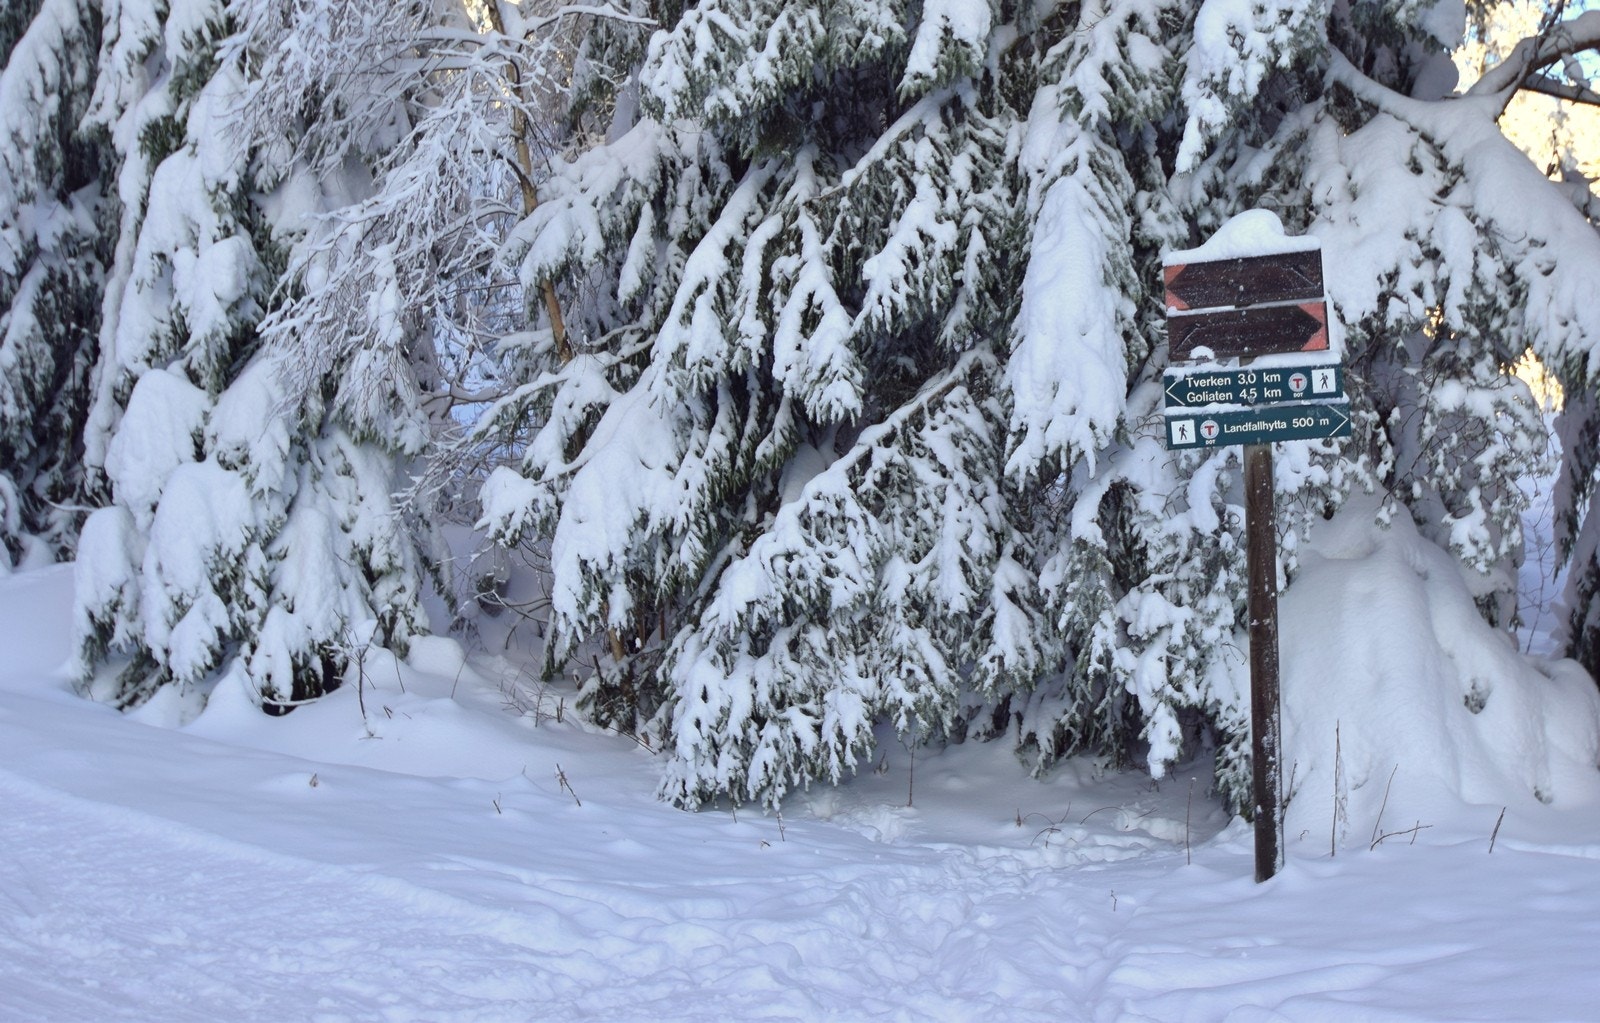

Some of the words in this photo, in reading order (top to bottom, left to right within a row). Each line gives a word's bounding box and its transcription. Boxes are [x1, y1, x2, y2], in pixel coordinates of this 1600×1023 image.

[1186, 376, 1231, 388] Tverken
[1237, 373, 1257, 385] 3,0
[1263, 372, 1281, 383] km
[1187, 390, 1233, 403] Goliaten
[1264, 387, 1282, 398] km
[1224, 421, 1287, 434] Landfallhytta
[1292, 417, 1314, 428] 500
[1319, 417, 1329, 426] m
